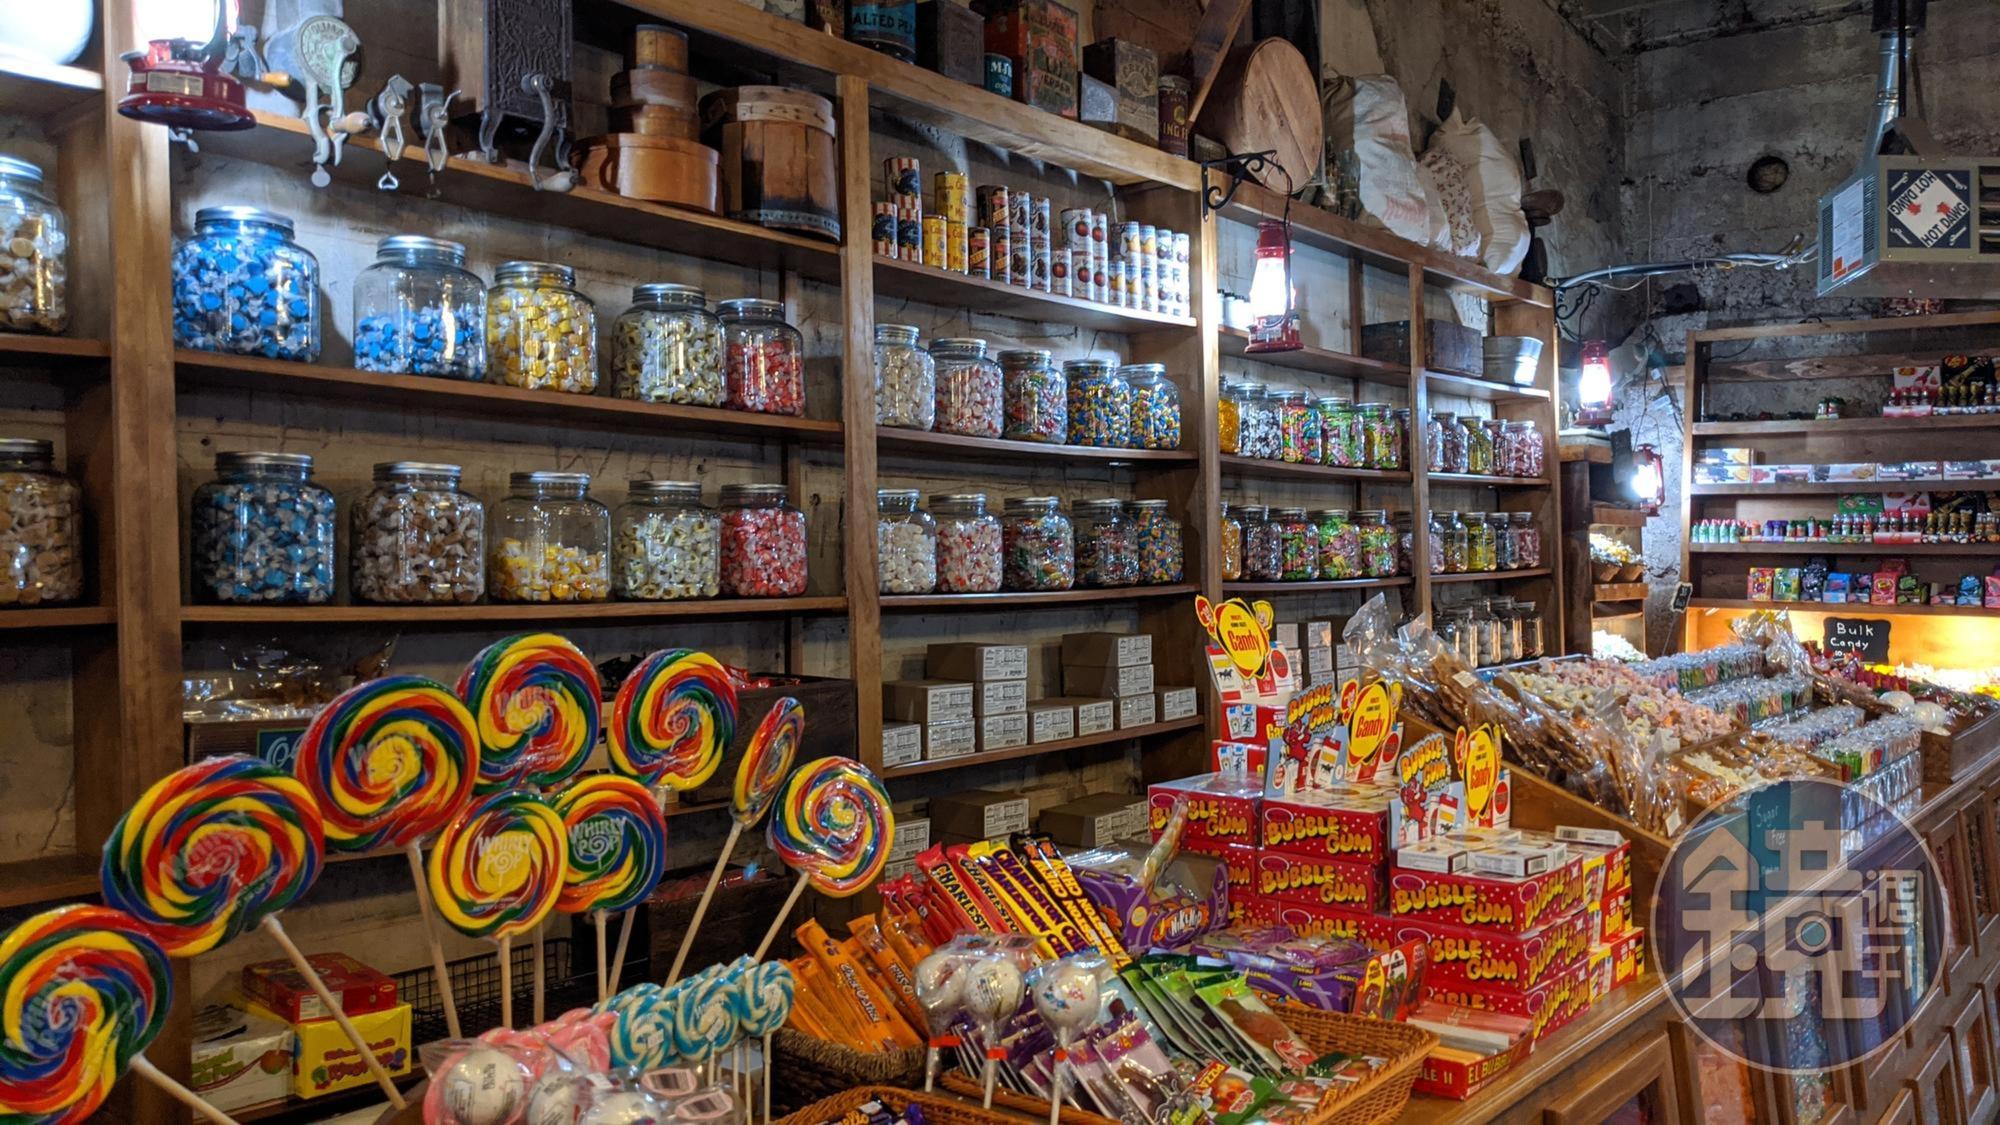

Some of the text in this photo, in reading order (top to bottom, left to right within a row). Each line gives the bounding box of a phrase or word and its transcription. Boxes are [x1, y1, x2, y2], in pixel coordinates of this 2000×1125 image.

[851, 12, 895, 28] ALTED
[1890, 171, 1937, 216] HOT DAWG
[1921, 202, 1968, 247] HOT DAWG
[1227, 629, 1261, 657] Candy
[1829, 637, 1869, 651] Candy
[1836, 622, 1874, 636] Bulk
[1288, 683, 1333, 725] BUBBLE
[1310, 706, 1335, 731] GUM
[1355, 712, 1385, 741] Candy
[1401, 736, 1443, 784] BUBBLE
[1422, 760, 1447, 789] GUM
[1151, 799, 1219, 830] BUBLE
[1206, 815, 1248, 837] GUM
[477, 833, 534, 857] WHIRLY
[568, 816, 627, 844] WHIRLY
[1265, 815, 1339, 846] BUBBLE
[1326, 833, 1373, 855] GUM
[992, 849, 1065, 926] CHARLESTON
[1030, 858, 1068, 898] CHEW
[1260, 864, 1336, 895] BUBBLE
[1320, 881, 1367, 904] GUM
[930, 862, 992, 933] CHARLEST
[959, 856, 1020, 932] CHARLESTO
[976, 854, 1049, 933] HARLESTON
[1393, 883, 1477, 914] BUBBLE
[1525, 868, 1564, 929] BUBBLE
[1461, 902, 1514, 925] GUM
[1431, 938, 1482, 963] BBLE
[1529, 922, 1568, 986] BUBBLE
[1466, 958, 1518, 980] GUM
[1533, 974, 1570, 1040] BUBBLE
[1199, 1063, 1226, 1089] PIZZA
